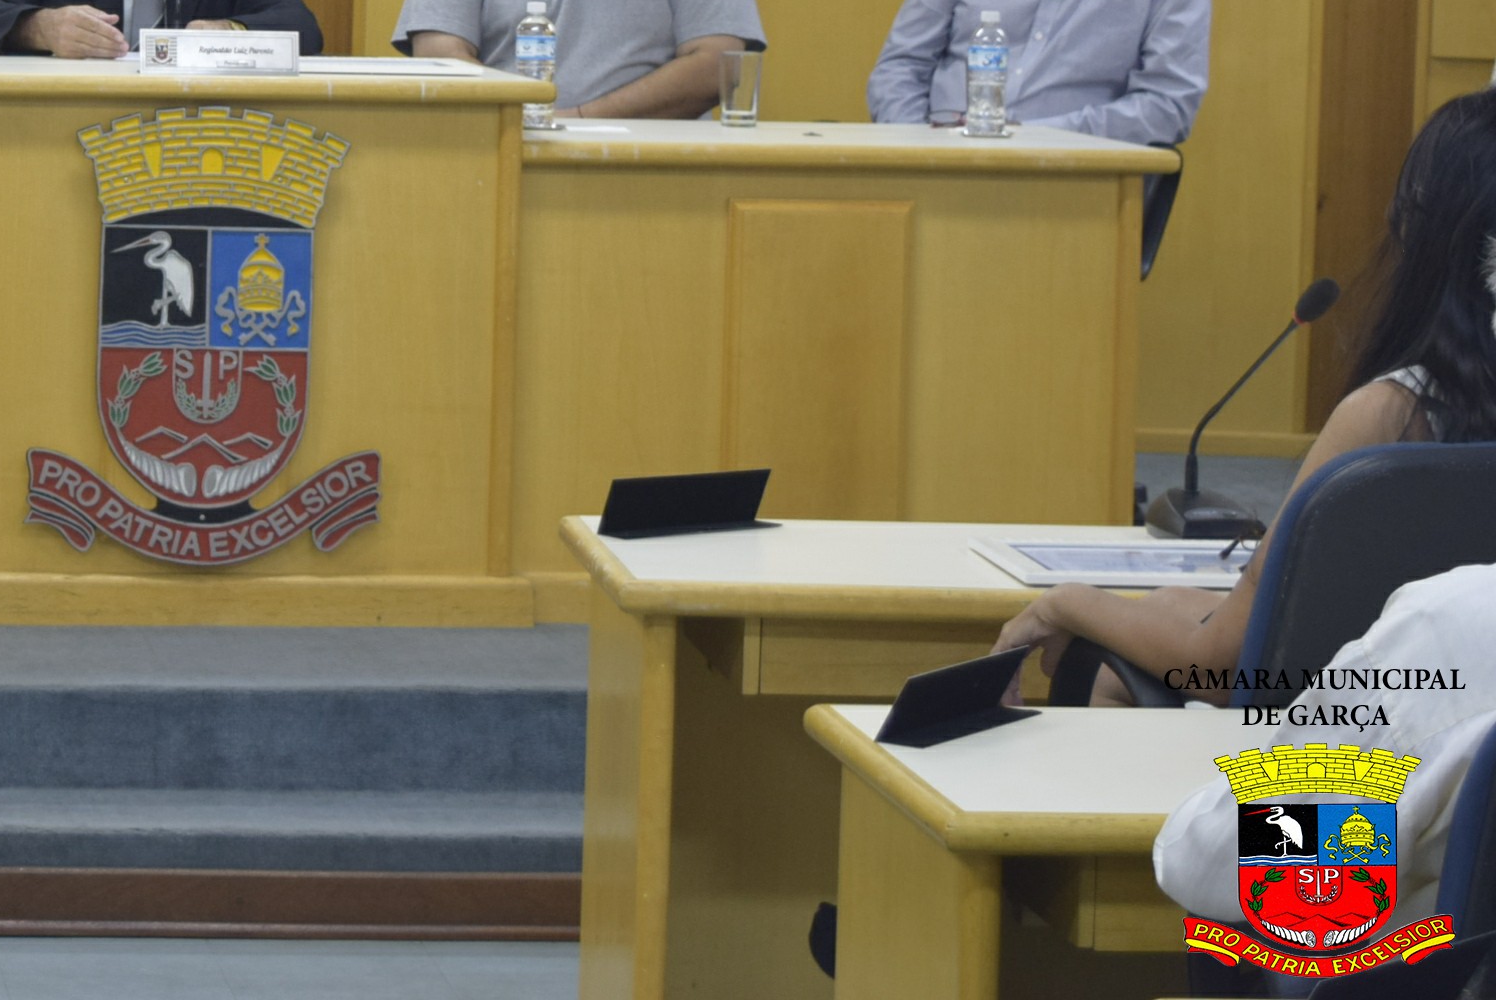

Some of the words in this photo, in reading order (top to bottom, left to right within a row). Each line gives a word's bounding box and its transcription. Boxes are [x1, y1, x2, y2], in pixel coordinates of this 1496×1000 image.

[39, 460, 99, 507] PRO
[97, 502, 201, 557] PATRIA
[211, 461, 371, 558] EXCELSIOR
